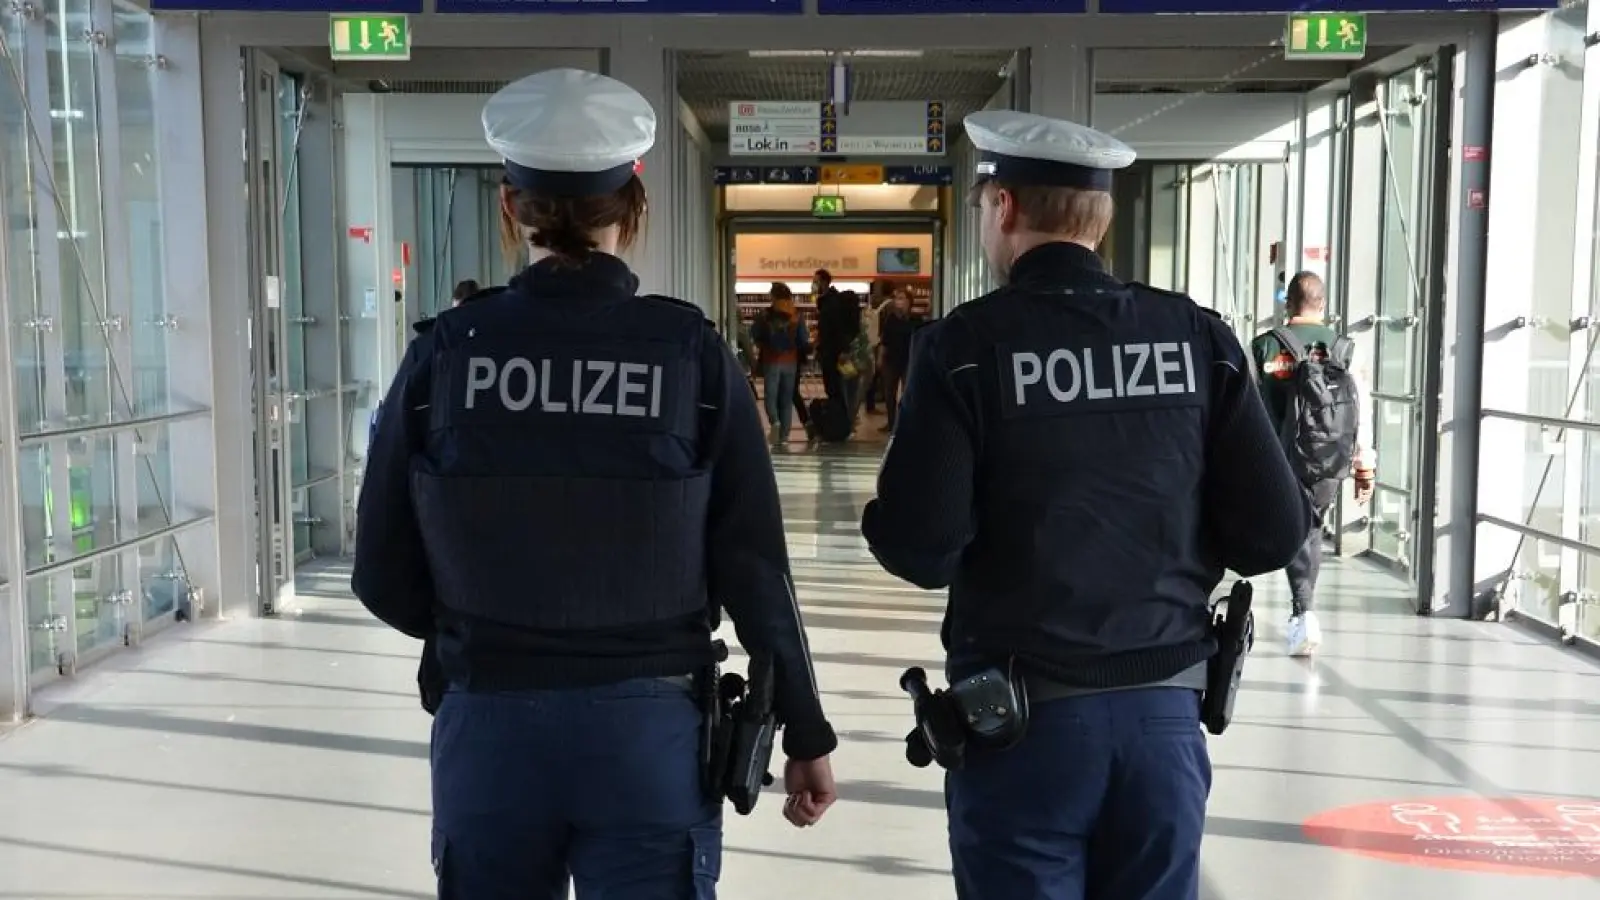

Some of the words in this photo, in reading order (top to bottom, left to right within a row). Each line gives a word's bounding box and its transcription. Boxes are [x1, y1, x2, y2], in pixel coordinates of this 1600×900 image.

[759, 256, 839, 269] ServiceStore
[464, 356, 664, 418] POLIZEI
[1011, 341, 1196, 406] POLIZEI
